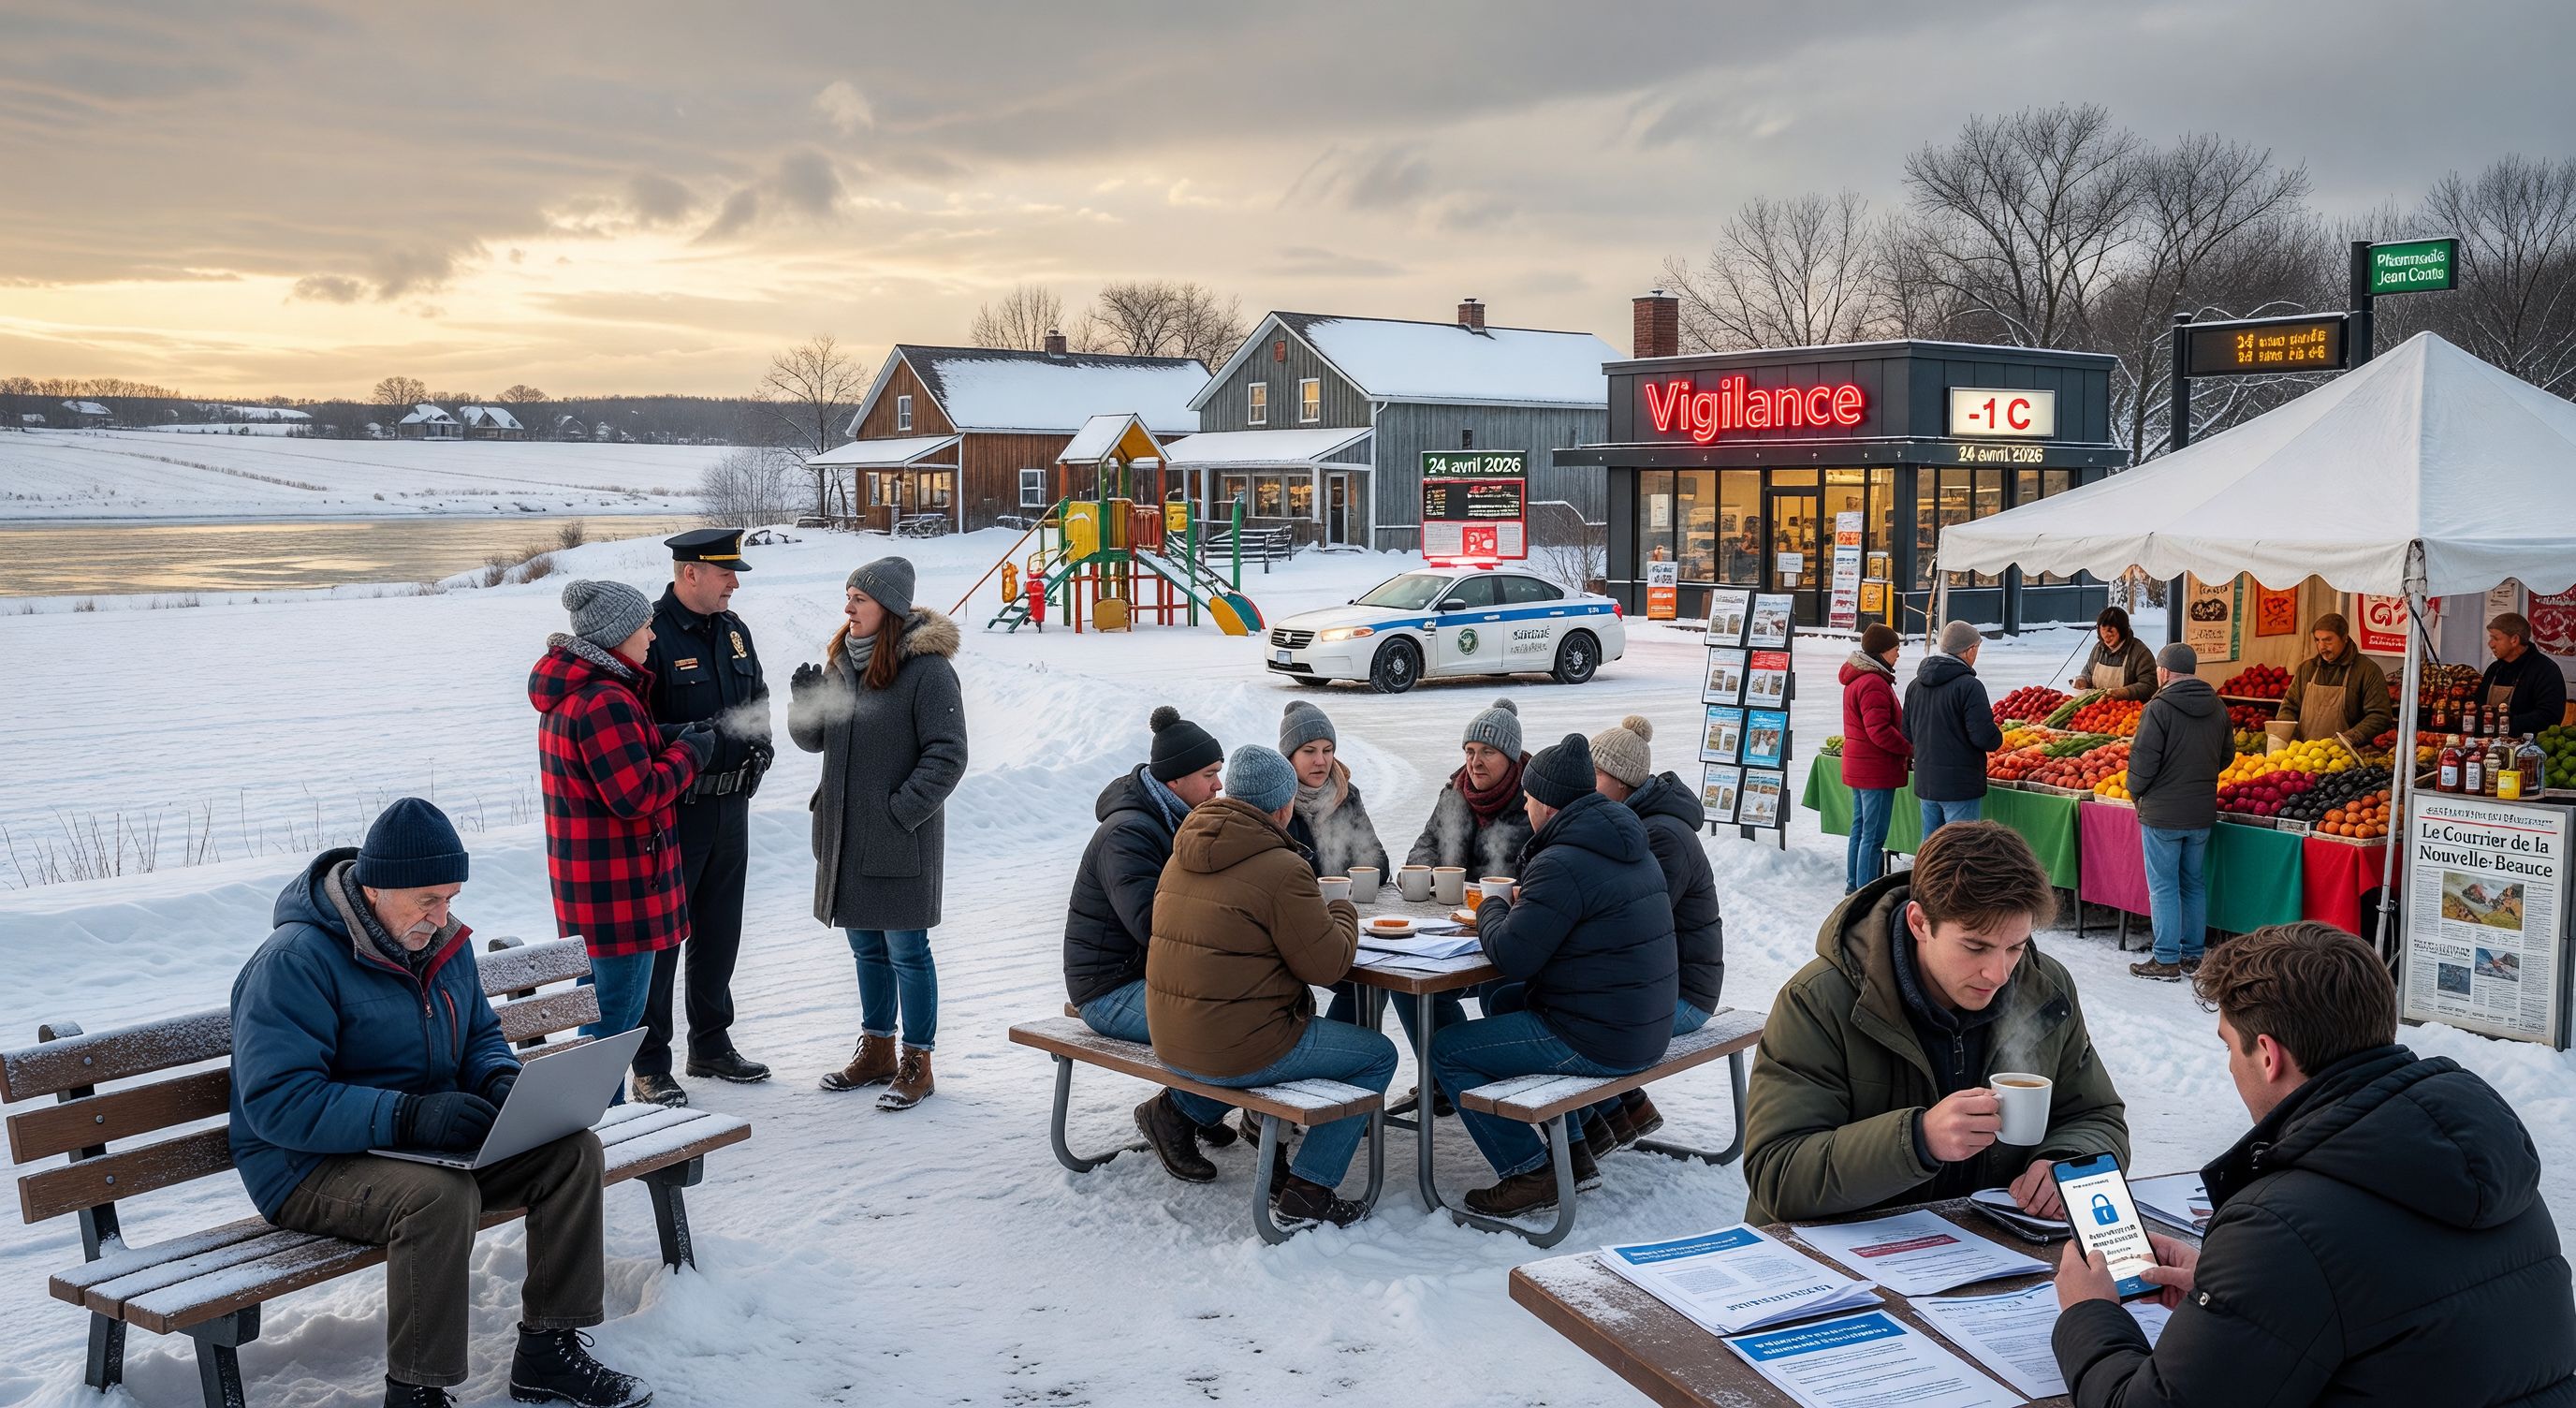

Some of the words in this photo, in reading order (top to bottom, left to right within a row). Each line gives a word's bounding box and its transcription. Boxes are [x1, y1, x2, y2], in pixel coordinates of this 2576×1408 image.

[1645, 376, 1863, 442] Vigilance
[1969, 398, 1996, 429] -1
[2007, 398, 2030, 430] C
[1428, 458, 1446, 474] 24
[1451, 457, 1481, 474] avril
[1484, 457, 1521, 473] 2026
[1958, 446, 1975, 462] 24
[2012, 447, 2043, 463] 2026
[2422, 823, 2440, 839] Le
[2443, 826, 2507, 848] Courrier
[2510, 834, 2529, 852] de
[2535, 836, 2549, 854] la
[2419, 844, 2553, 878] Nouvelle-Beauce
